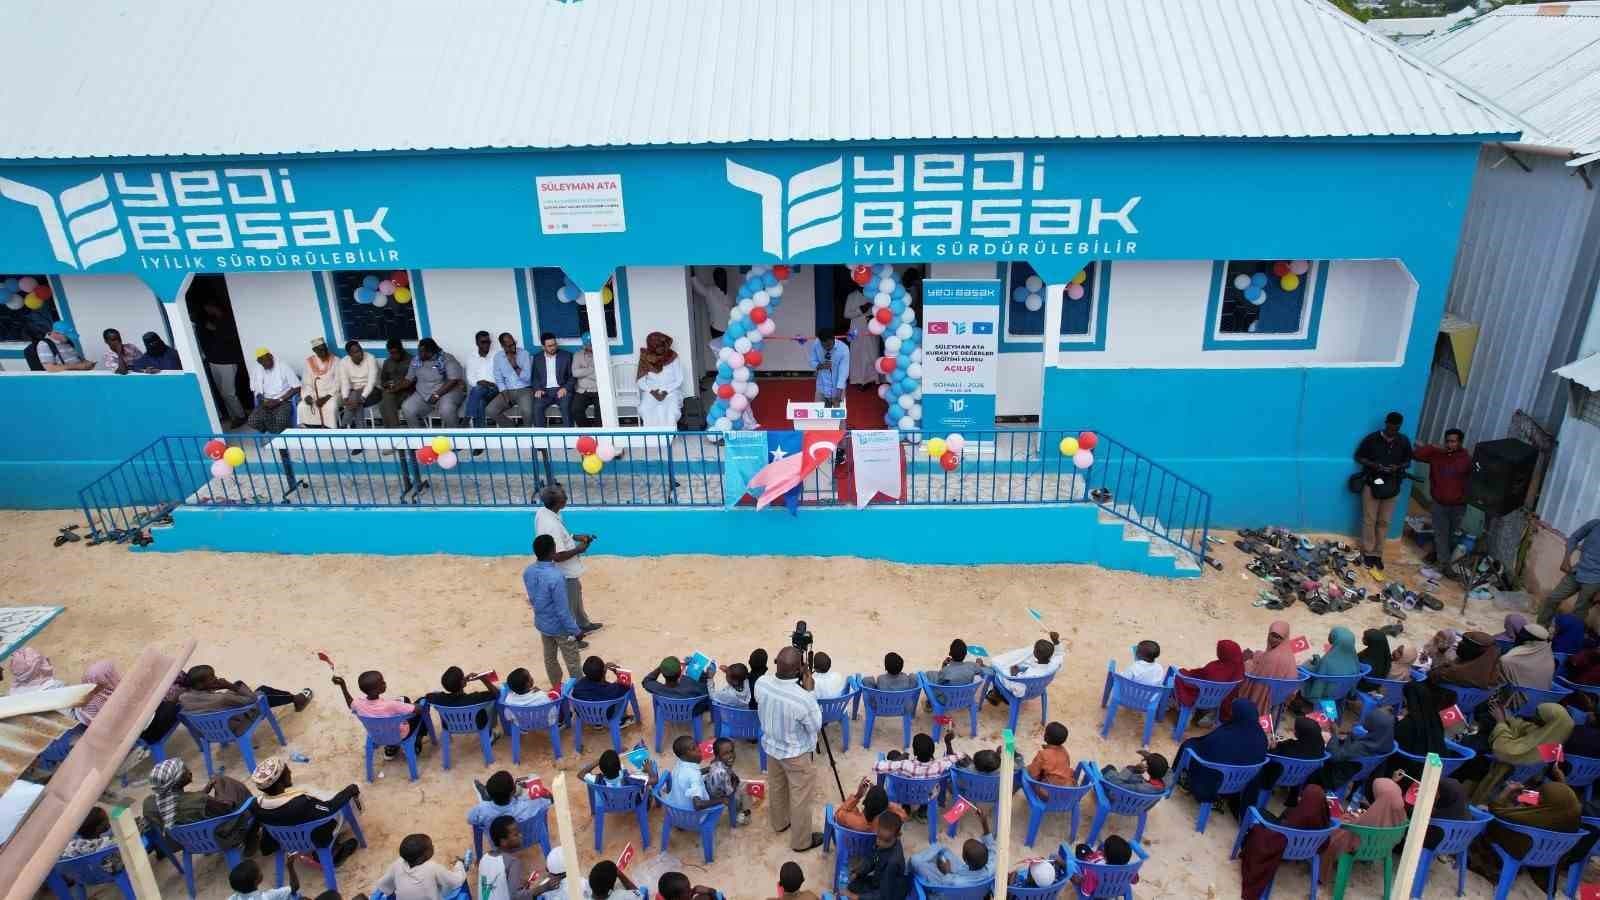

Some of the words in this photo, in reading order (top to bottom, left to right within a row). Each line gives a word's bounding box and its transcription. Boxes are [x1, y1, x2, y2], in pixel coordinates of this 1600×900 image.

[541, 181, 594, 192] SÜLEYMAN
[597, 181, 617, 190] ATA
[853, 241, 922, 257] İYİLİK
[936, 240, 1137, 256] SÜRDÜRÜLEBİLİR
[141, 254, 204, 271] İYİLİK
[216, 249, 400, 268] SÜRDÜRÜLEBİLİR
[944, 365, 975, 373] AÇILIŞI
